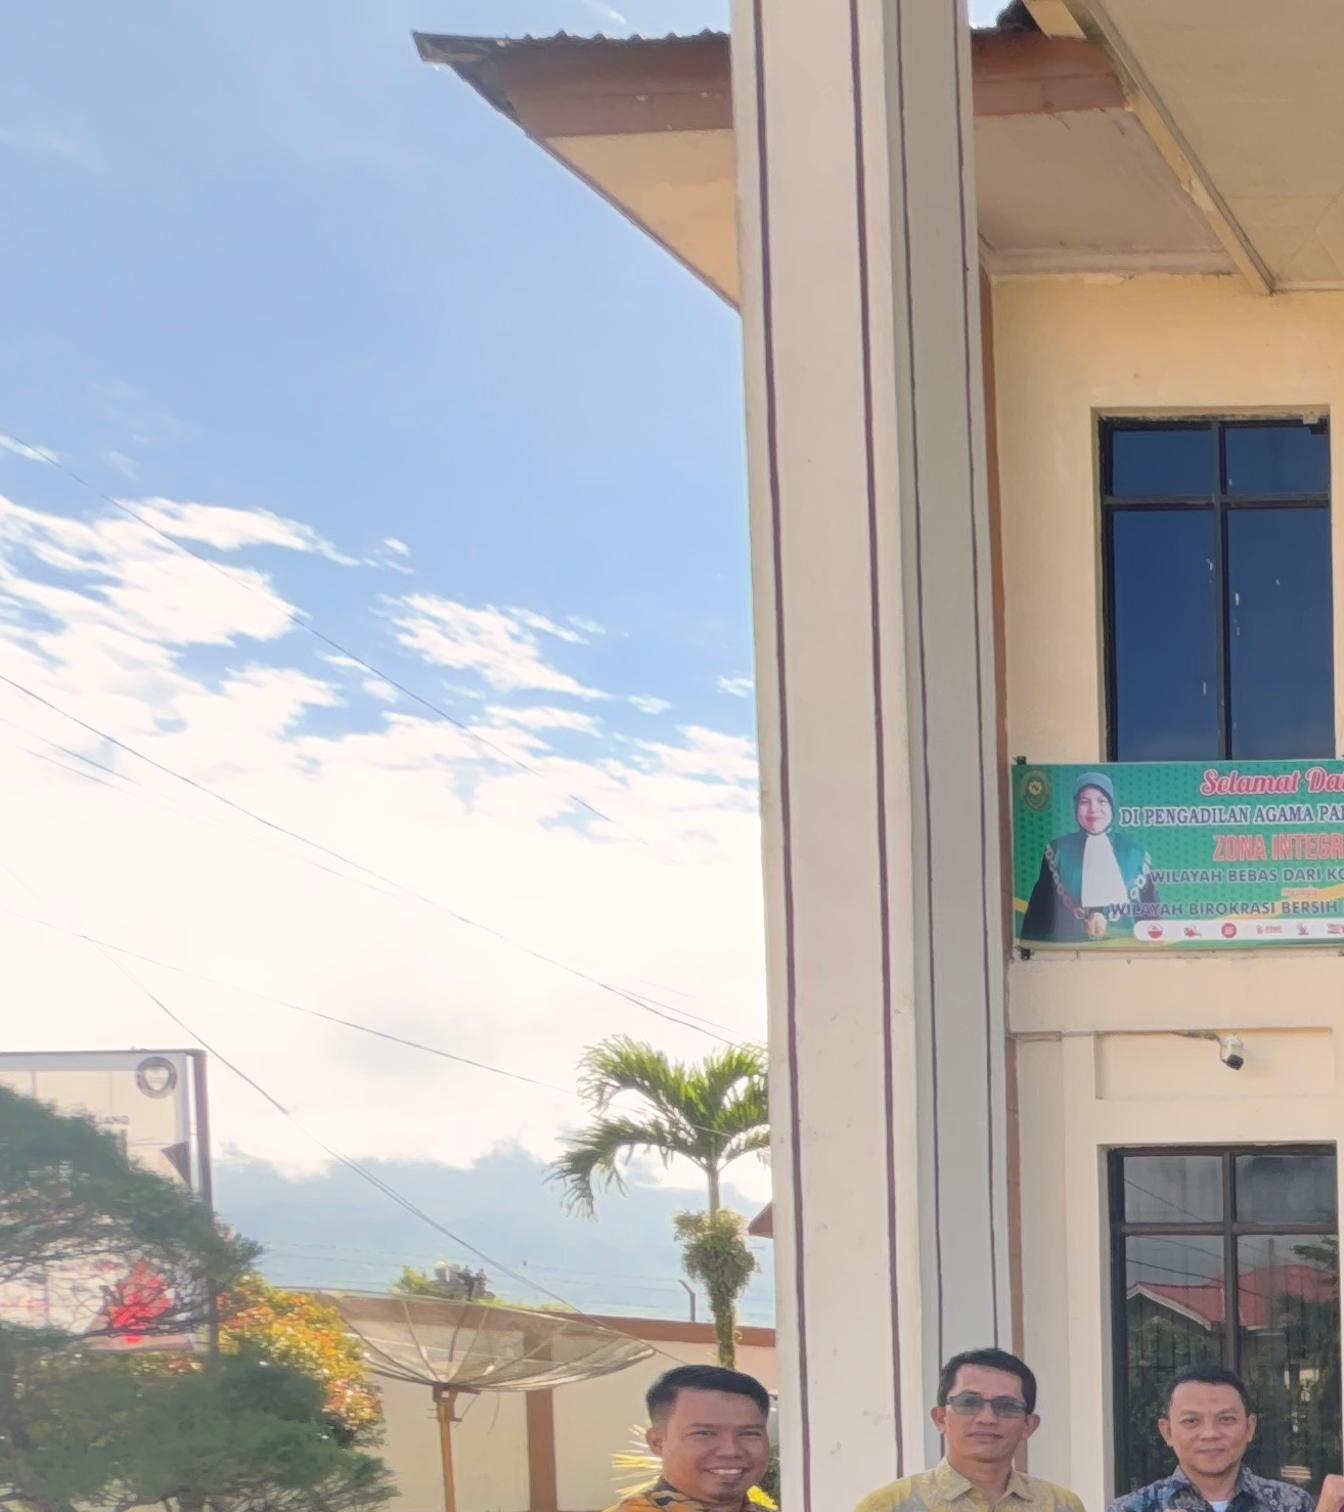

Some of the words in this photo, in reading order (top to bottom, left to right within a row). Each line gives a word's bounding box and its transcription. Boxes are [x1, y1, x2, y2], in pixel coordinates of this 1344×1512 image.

[1200, 768, 1302, 796] Selamat
[1120, 807, 1140, 826] DI
[1145, 806, 1250, 825] PENGADILAN
[1253, 804, 1315, 824] AGAMA
[1213, 834, 1268, 861] ZONA
[1151, 870, 1223, 884] WILAYAH
[1228, 869, 1278, 883] BEBAS
[1283, 867, 1321, 882] DARI
[1110, 903, 1184, 917] WILAYAH
[1189, 902, 1276, 916] BIROKRASI
[1281, 901, 1338, 914] BERSIH
